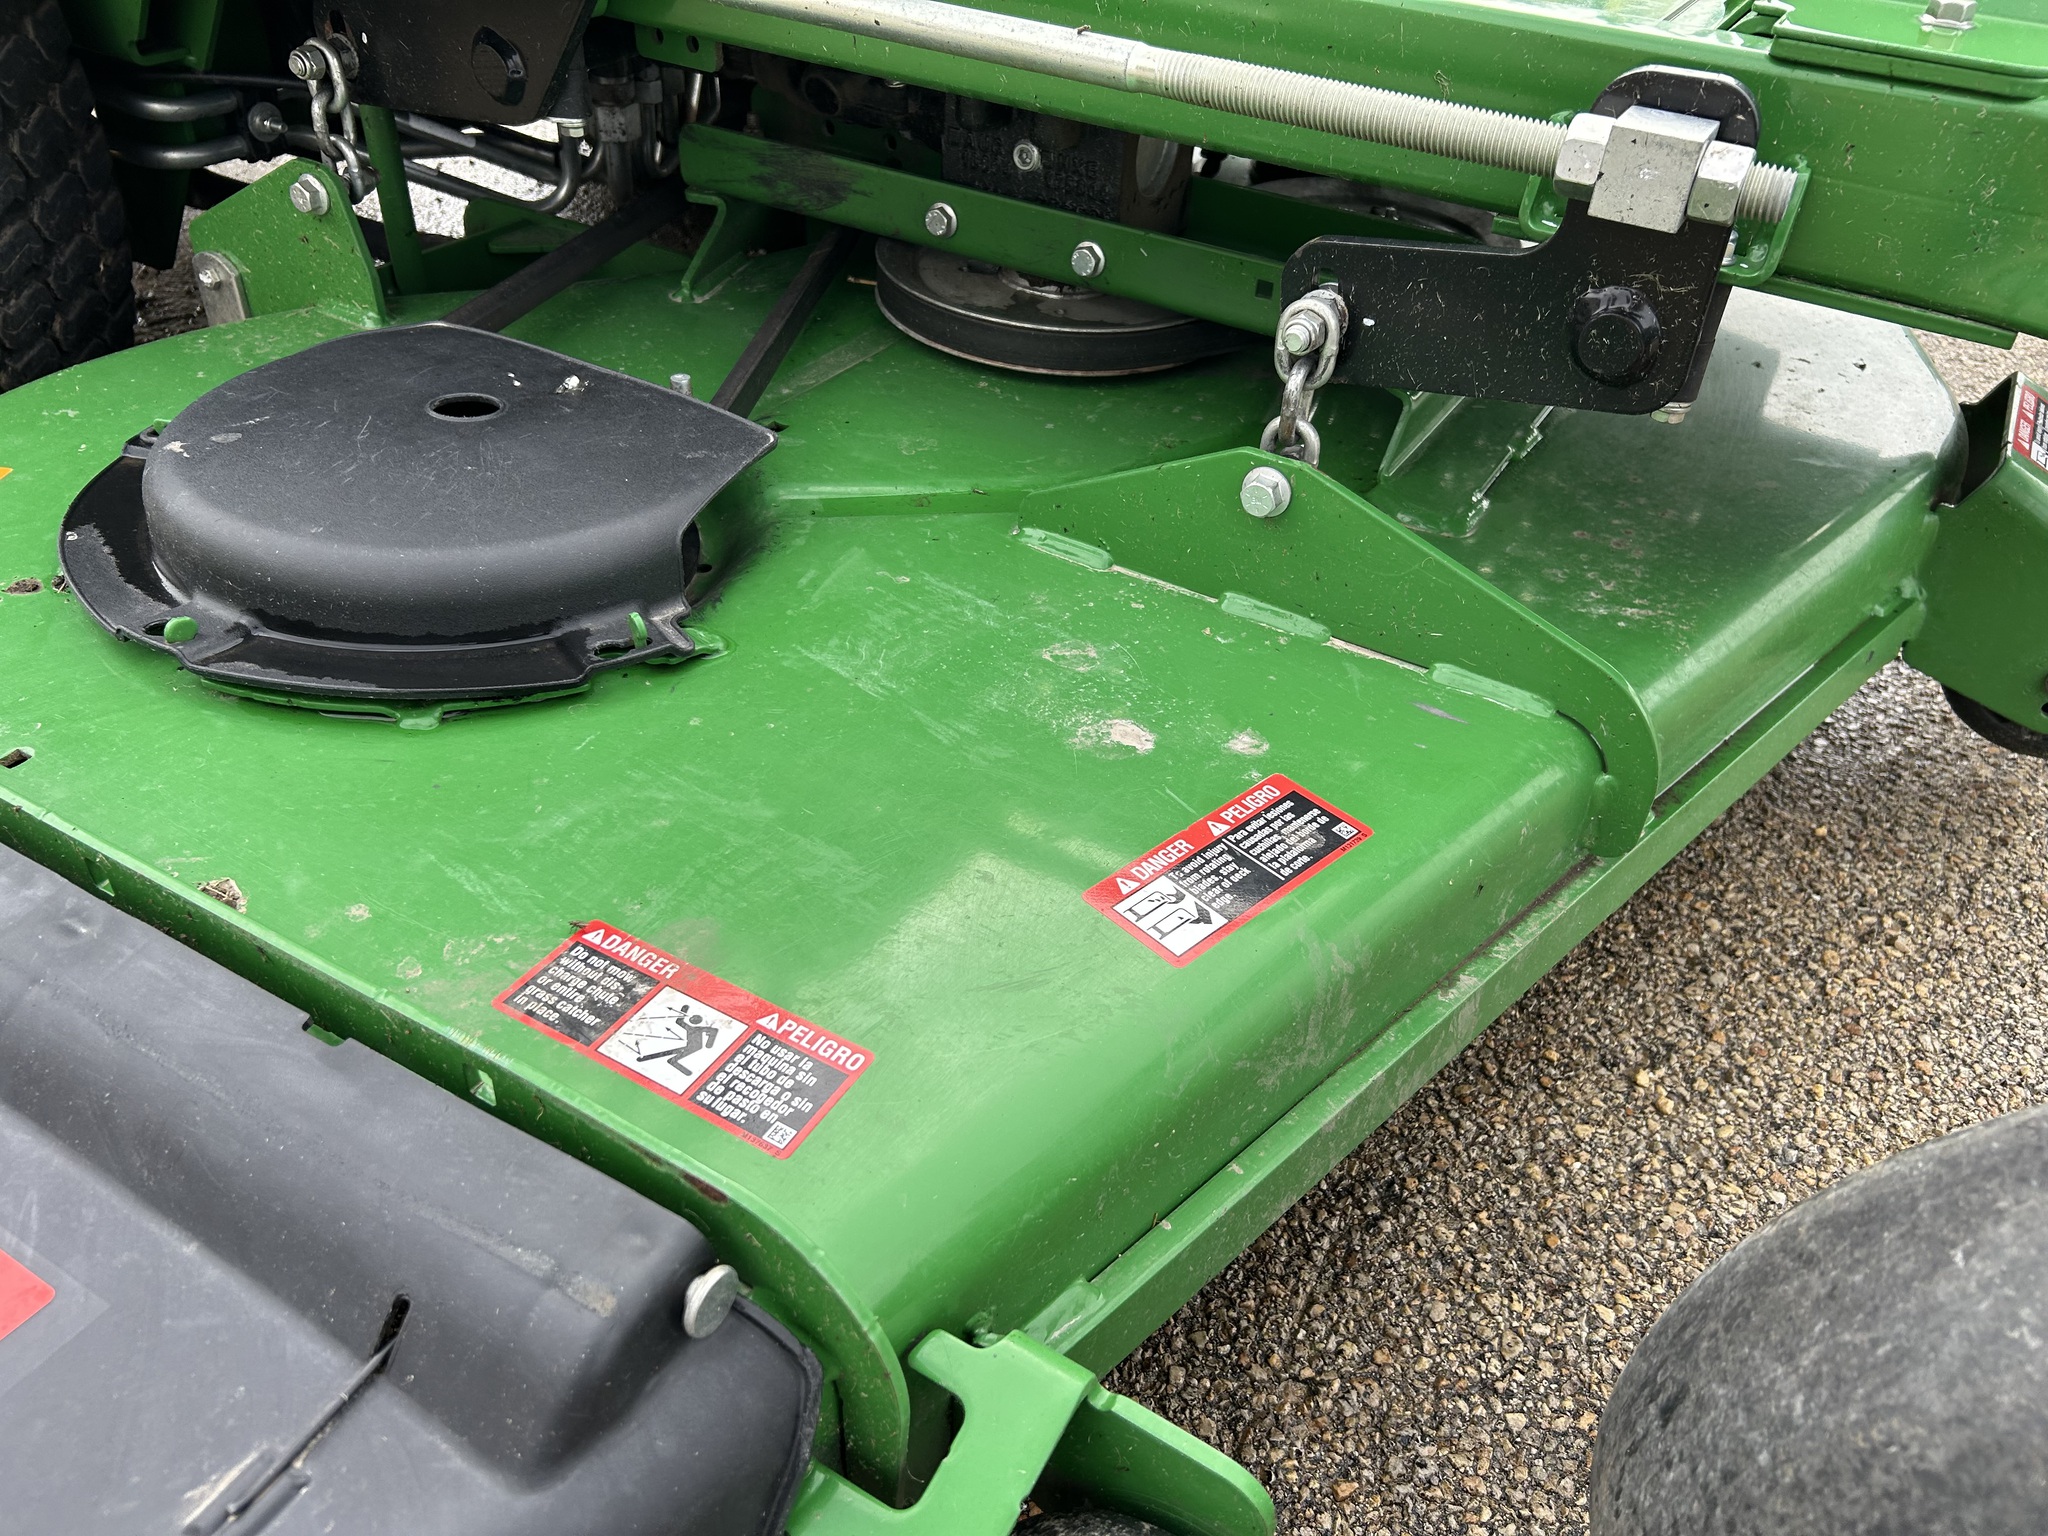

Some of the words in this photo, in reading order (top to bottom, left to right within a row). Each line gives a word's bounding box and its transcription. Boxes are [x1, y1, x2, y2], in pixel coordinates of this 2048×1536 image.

[1219, 784, 1281, 824] PELIGRO
[1228, 829, 1248, 843] Para
[1245, 813, 1268, 833] evitar
[1263, 800, 1295, 821] lesiones
[1280, 808, 1322, 836] mantenerse
[1239, 826, 1274, 850] causadas
[1270, 818, 1286, 832] por
[1283, 811, 1296, 822] las
[1259, 842, 1289, 863] alejado
[1285, 832, 1301, 846] del
[1296, 821, 1321, 838] borde
[1316, 815, 1330, 825] de
[1130, 838, 1195, 880] DANGER
[1168, 868, 1184, 880] To
[1181, 855, 1206, 874] avoid
[1202, 842, 1229, 861] injury
[1178, 871, 1202, 888] from
[1199, 853, 1232, 876] rotating
[1268, 860, 1281, 870] la
[1277, 837, 1317, 866] plataforma
[1279, 865, 1293, 877] de
[1291, 855, 1314, 871] corte.
[1189, 872, 1223, 895] blades,
[1219, 861, 1241, 877] stay
[1200, 885, 1223, 902] clear
[1220, 878, 1234, 889] of
[559, 956, 604, 981] without
[569, 945, 588, 960] Do
[587, 955, 607, 969] not
[606, 963, 636, 983] mow
[600, 934, 680, 980] DANGER
[536, 975, 552, 988] or
[550, 981, 584, 1003] entire
[548, 966, 588, 990] charge
[513, 992, 525, 1006] in
[524, 1000, 561, 1024] place.
[524, 984, 557, 1005] grass
[557, 1000, 602, 1027] catcher
[751, 1033, 769, 1049] No
[769, 1043, 801, 1064] usar
[798, 1055, 814, 1071] la
[776, 1019, 866, 1071] PELIGRO
[724, 1062, 782, 1096] descarga
[780, 1090, 792, 1101] o
[791, 1096, 814, 1113] sin
[733, 1053, 748, 1066] el
[747, 1058, 777, 1078] tubo
[776, 1075, 795, 1089] de
[795, 1069, 818, 1087] sin
[696, 1090, 712, 1105] su
[710, 1095, 748, 1124] lugar.
[705, 1080, 726, 1095] de
[723, 1091, 761, 1115] pasto
[759, 1109, 779, 1125] en
[715, 1071, 730, 1085] el
[728, 1078, 795, 1117] recogedor
